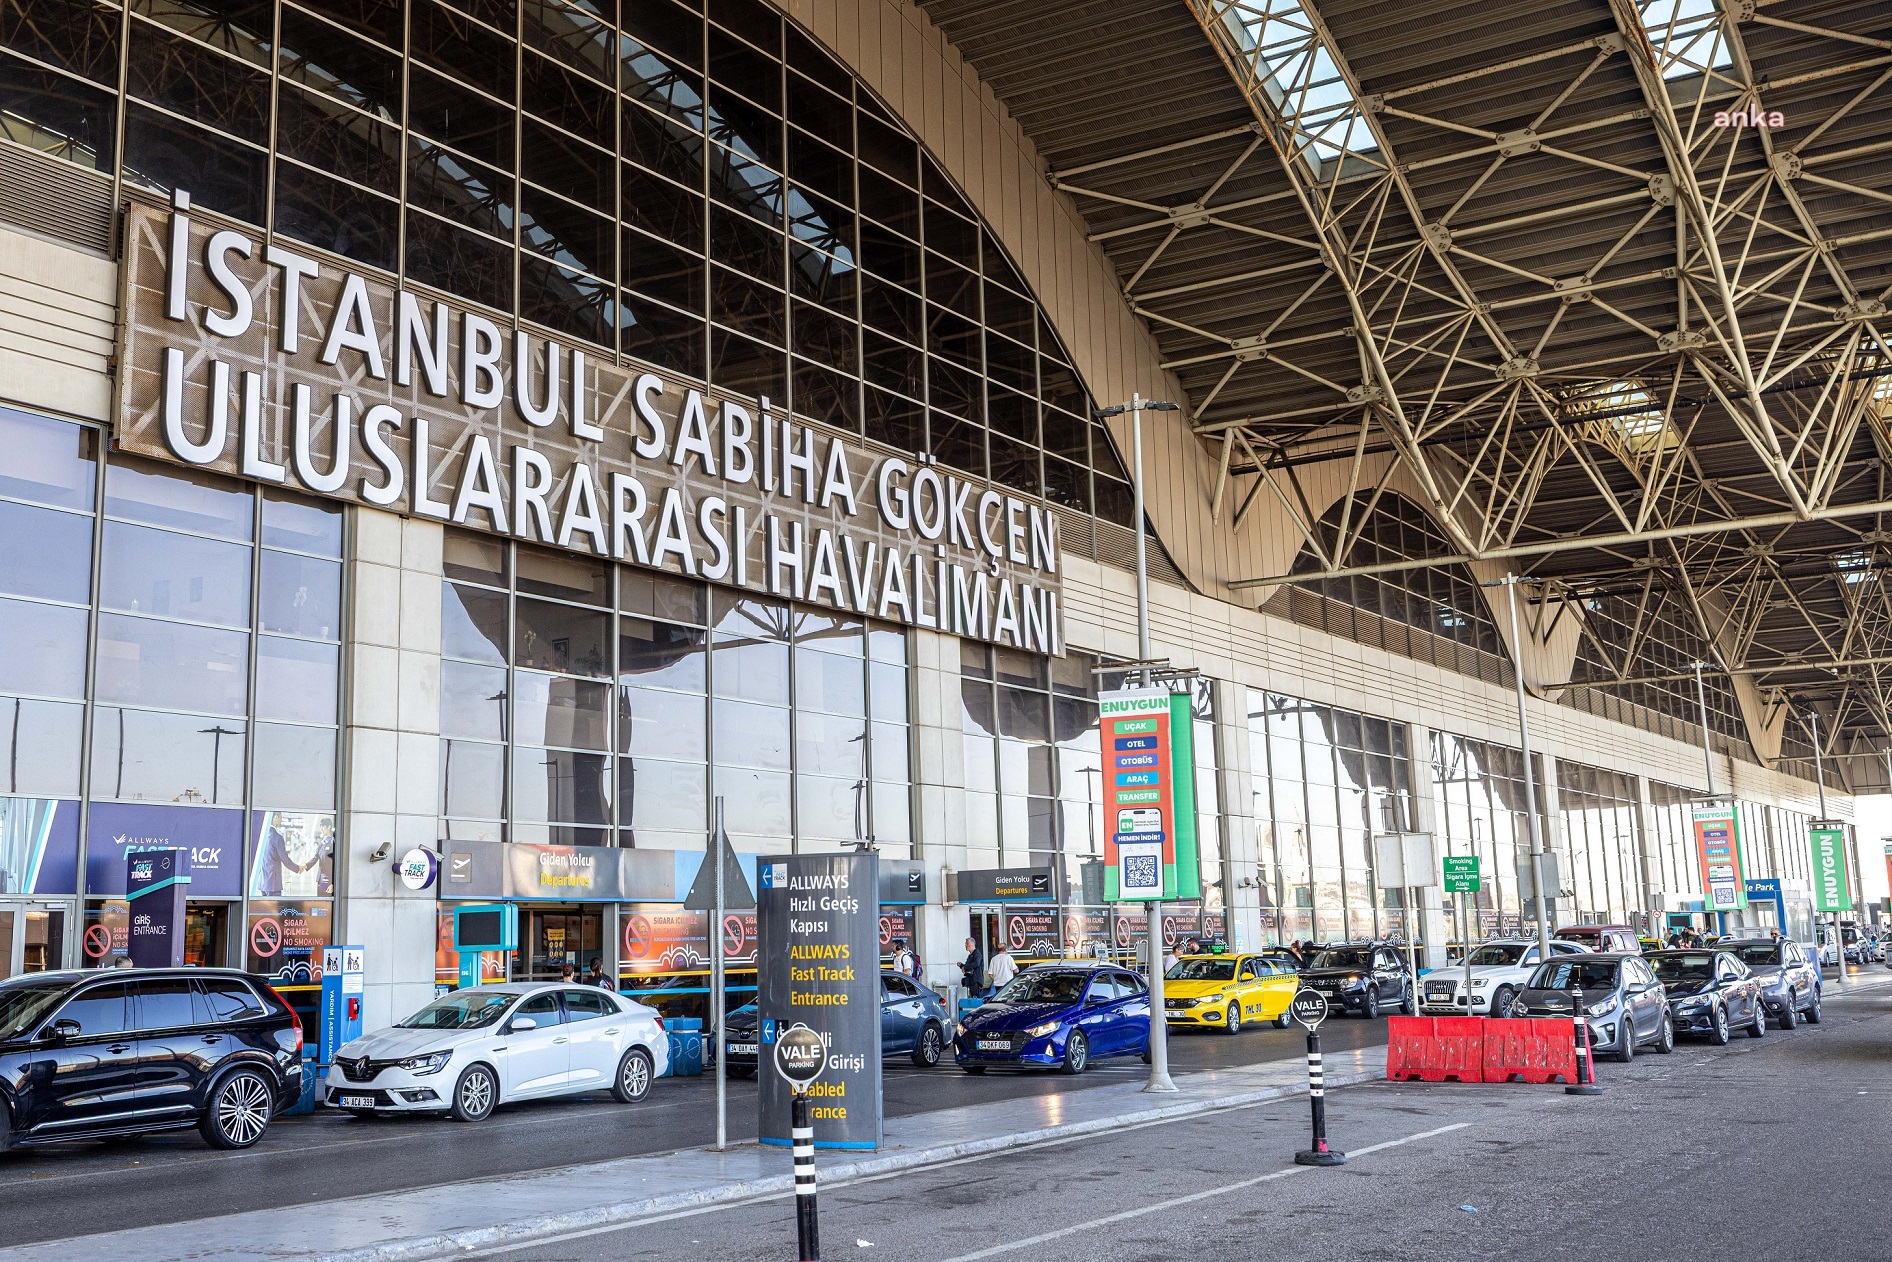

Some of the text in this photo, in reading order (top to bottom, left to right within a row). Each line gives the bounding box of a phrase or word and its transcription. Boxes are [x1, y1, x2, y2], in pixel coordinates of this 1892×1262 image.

[164, 188, 1055, 577] İSTANBUL SABİHA GÖKÇEN
[162, 347, 1058, 657] ULUSLARARASI HAVALİMANI
[1101, 697, 1168, 713] ENUYGUN
[1124, 722, 1146, 732] UÇAK
[1126, 740, 1146, 748] OTEL
[1121, 756, 1153, 766] OTOBÜS
[1126, 775, 1149, 784] ARAÇ
[1119, 792, 1158, 800] TRANSFER
[1694, 811, 1733, 820] ENUYGUN
[1121, 821, 1133, 829] EN
[128, 837, 169, 845] ALLWAYS
[539, 852, 591, 867] Giden Yolcu
[130, 870, 153, 880] TRACK
[1446, 873, 1464, 881] Sigara
[1820, 835, 1839, 907] ENUYGUN
[540, 872, 590, 889] Departures
[789, 875, 849, 890] ALLWAYS
[995, 875, 1030, 884] Giden Yolcu
[995, 887, 1028, 896] Departures
[1755, 883, 1774, 891] Park
[790, 895, 859, 915] Hızlı Geçiş
[133, 926, 167, 935] ENTRANCE
[790, 918, 828, 936] Kapısı
[284, 938, 324, 946] NO SMOKING
[790, 944, 851, 960] ALLWAYS
[791, 964, 855, 981] Fast Track
[791, 990, 849, 1006] Entrance
[1294, 999, 1324, 1011] VALE
[780, 1044, 821, 1060] VALE
[829, 1053, 865, 1073] Girişi
[811, 1106, 847, 1119] rance
